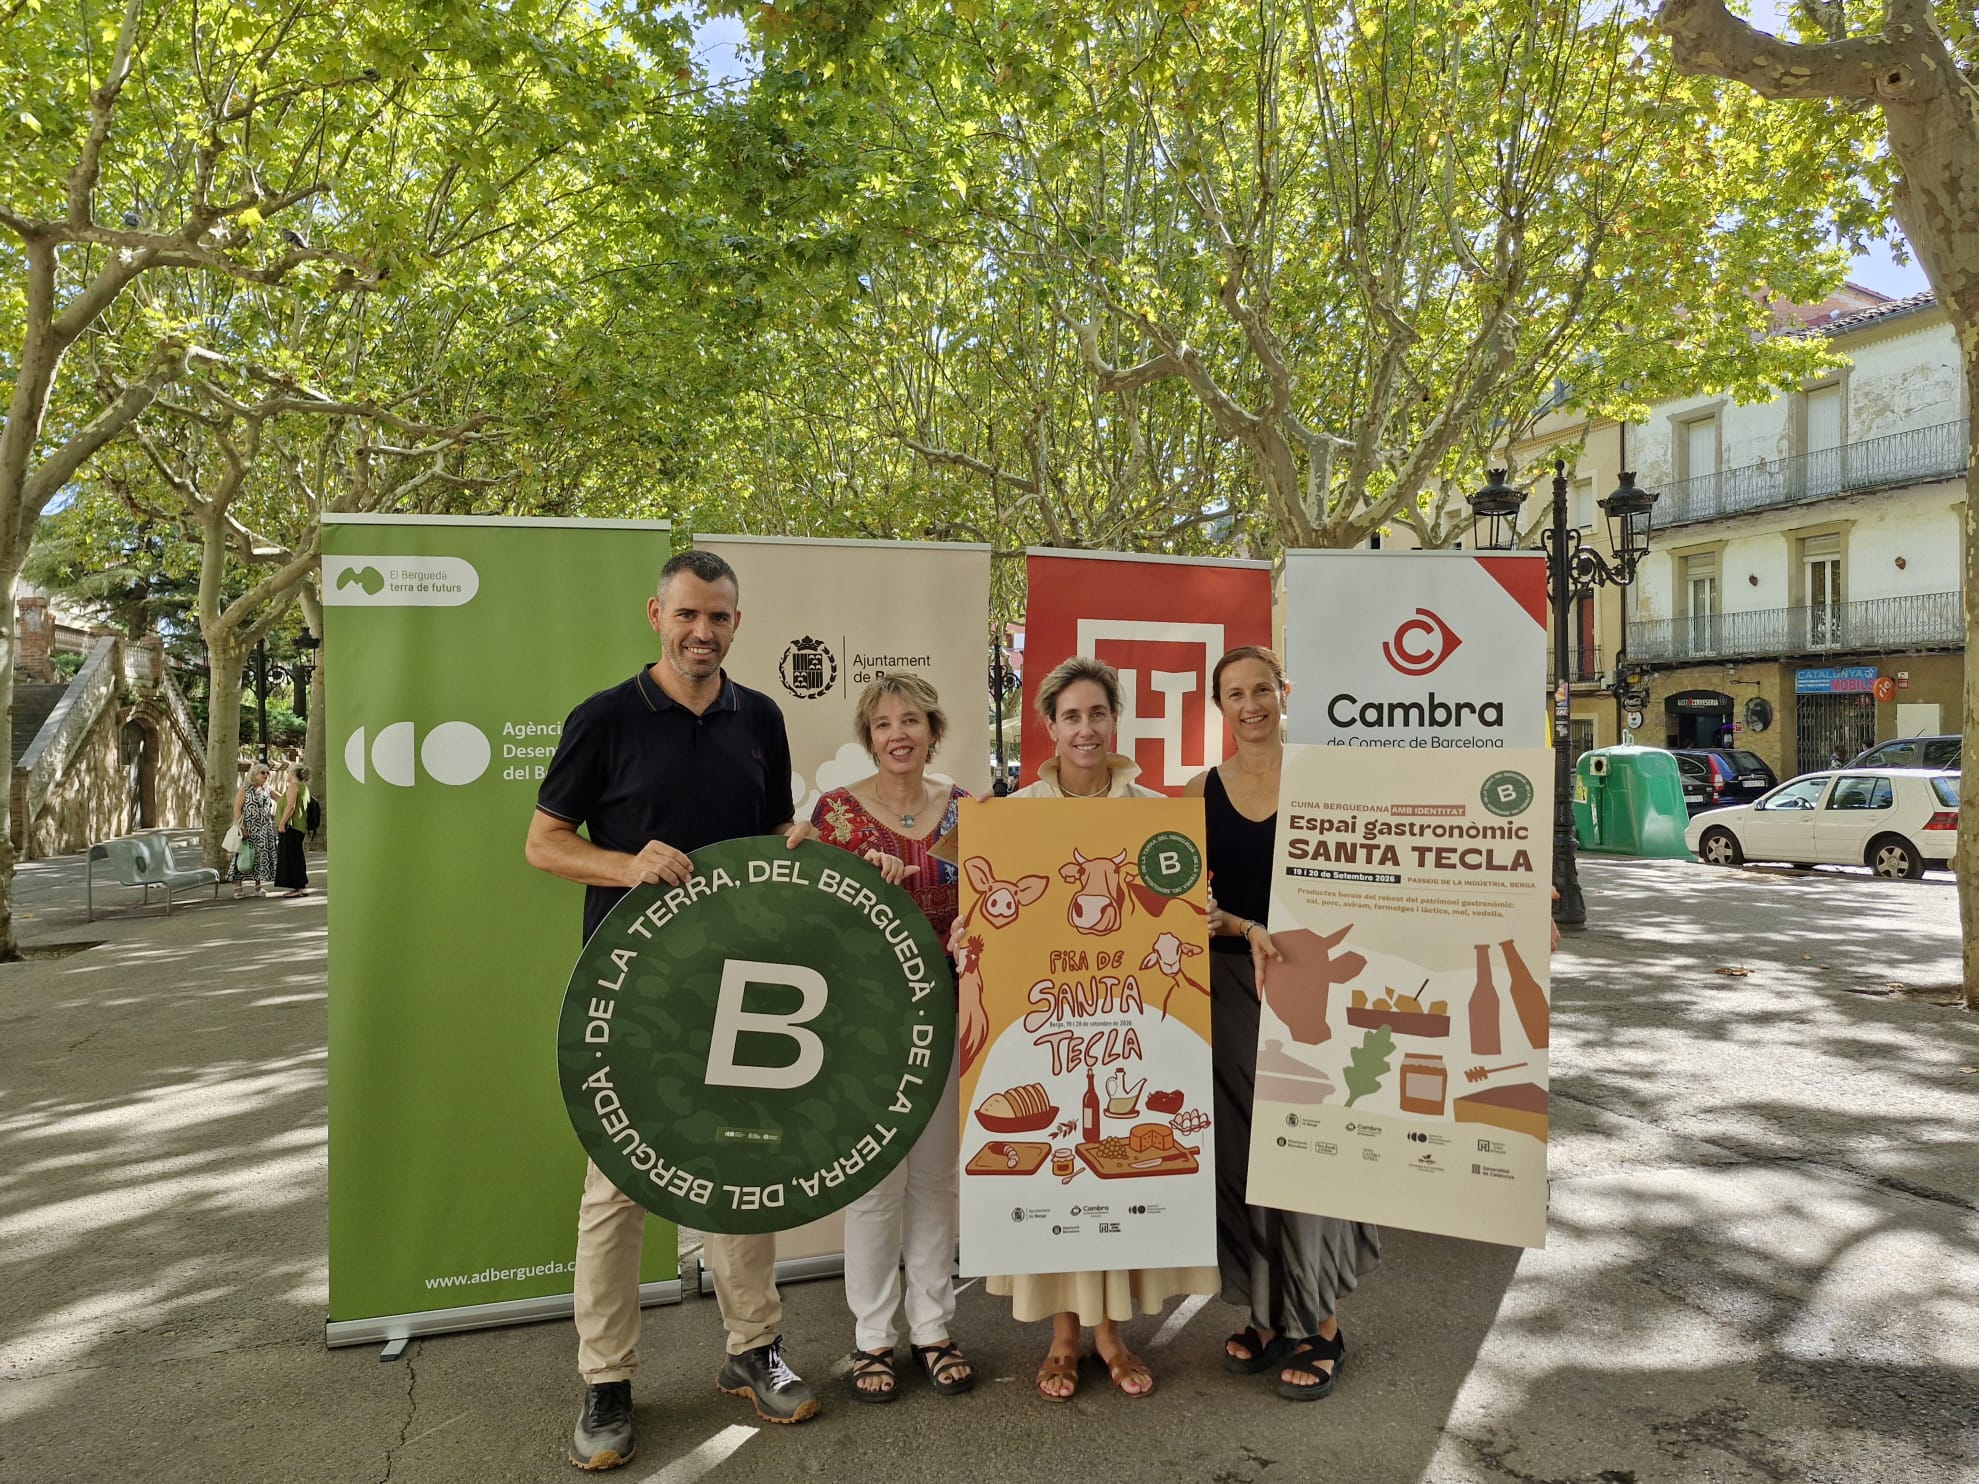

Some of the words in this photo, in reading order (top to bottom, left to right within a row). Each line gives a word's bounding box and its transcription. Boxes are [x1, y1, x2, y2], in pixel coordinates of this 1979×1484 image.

[390, 583, 414, 592] terra
[416, 583, 429, 592] de
[432, 583, 462, 593] futurs
[853, 654, 931, 668] Ajuntament
[853, 671, 871, 683] de
[1327, 692, 1503, 728] Cambra
[502, 721, 561, 740] Agènci
[1409, 736, 1428, 748] de
[1431, 736, 1504, 748] Barcelona
[503, 743, 558, 759] Desen
[503, 765, 530, 780] del
[1497, 784, 1517, 803] B
[1291, 800, 1321, 810] CUINA
[1323, 802, 1389, 813] BERGUEDANA
[1392, 806, 1413, 815] AMB
[1415, 806, 1465, 816] IDENTITAT
[1289, 814, 1357, 836] Espai
[1363, 818, 1529, 841] gastronòmic
[1159, 851, 1181, 875] B
[1288, 838, 1401, 867] SANTA
[1411, 845, 1534, 872] TECLA
[747, 859, 810, 886] DEL
[1293, 868, 1303, 876] 19
[1308, 868, 1319, 877] 20
[1320, 870, 1332, 879] de
[1333, 871, 1374, 882] Setembre
[1375, 874, 1396, 883] 2026
[1407, 877, 1439, 885] PASSEIG
[626, 866, 742, 941] TERRA,
[1297, 887, 1337, 897] Productes
[1363, 893, 1377, 901] del
[1405, 896, 1418, 904] del
[816, 867, 937, 1003] BERGUEDÀ
[597, 948, 639, 992] LA
[1096, 950, 1125, 971] DE
[1023, 974, 1144, 1033] SANTA
[584, 997, 615, 1044] DE
[704, 958, 829, 1090] B
[907, 1024, 934, 1068] DE
[1033, 1027, 1143, 1076] TECLA
[888, 1073, 924, 1115] LA
[581, 1065, 715, 1205] BERGUEDÀ
[790, 1122, 899, 1198] TERRA,
[722, 1183, 785, 1210] DEL
[425, 1260, 576, 1289] www.adbergueda.c
